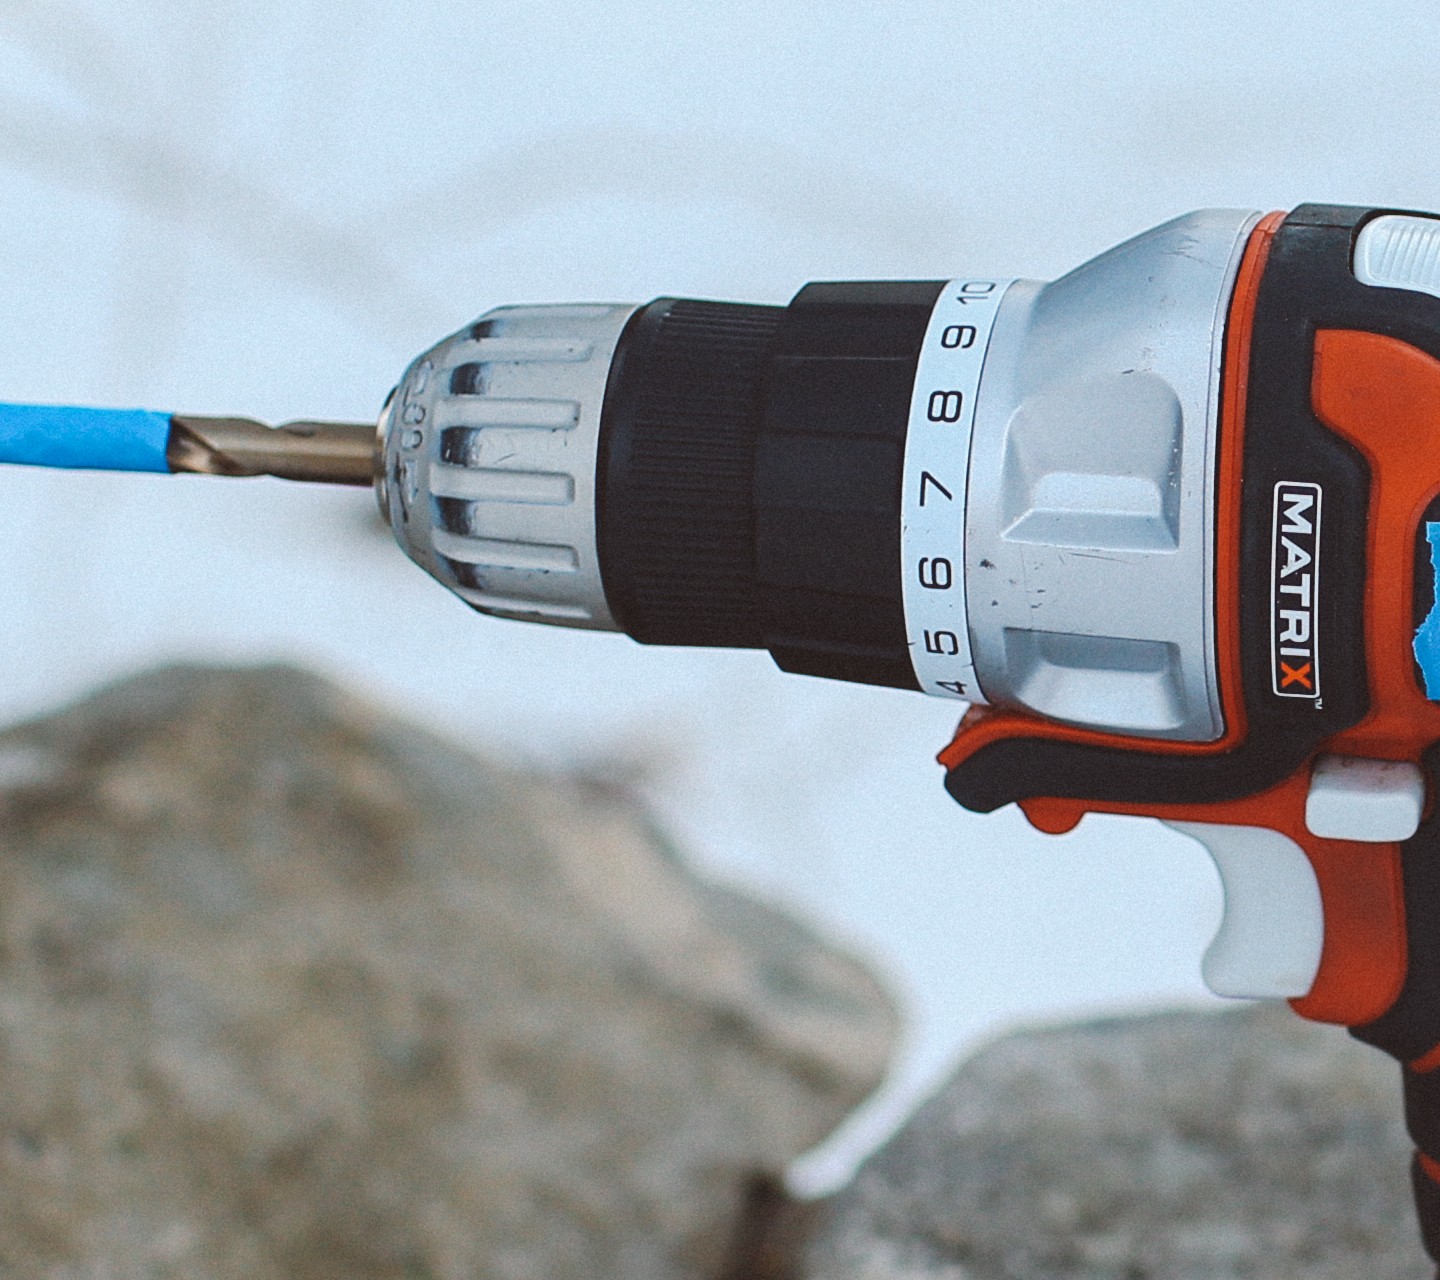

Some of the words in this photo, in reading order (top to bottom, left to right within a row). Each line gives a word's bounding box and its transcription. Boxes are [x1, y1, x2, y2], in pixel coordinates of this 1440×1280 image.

[955, 281, 998, 306] 10
[940, 324, 978, 349] 9
[926, 390, 963, 423] 8
[919, 470, 953, 508] 7
[917, 556, 953, 590] 6
[1278, 492, 1314, 691] MATRIX
[923, 628, 959, 656] 5
[934, 679, 968, 696] 4
